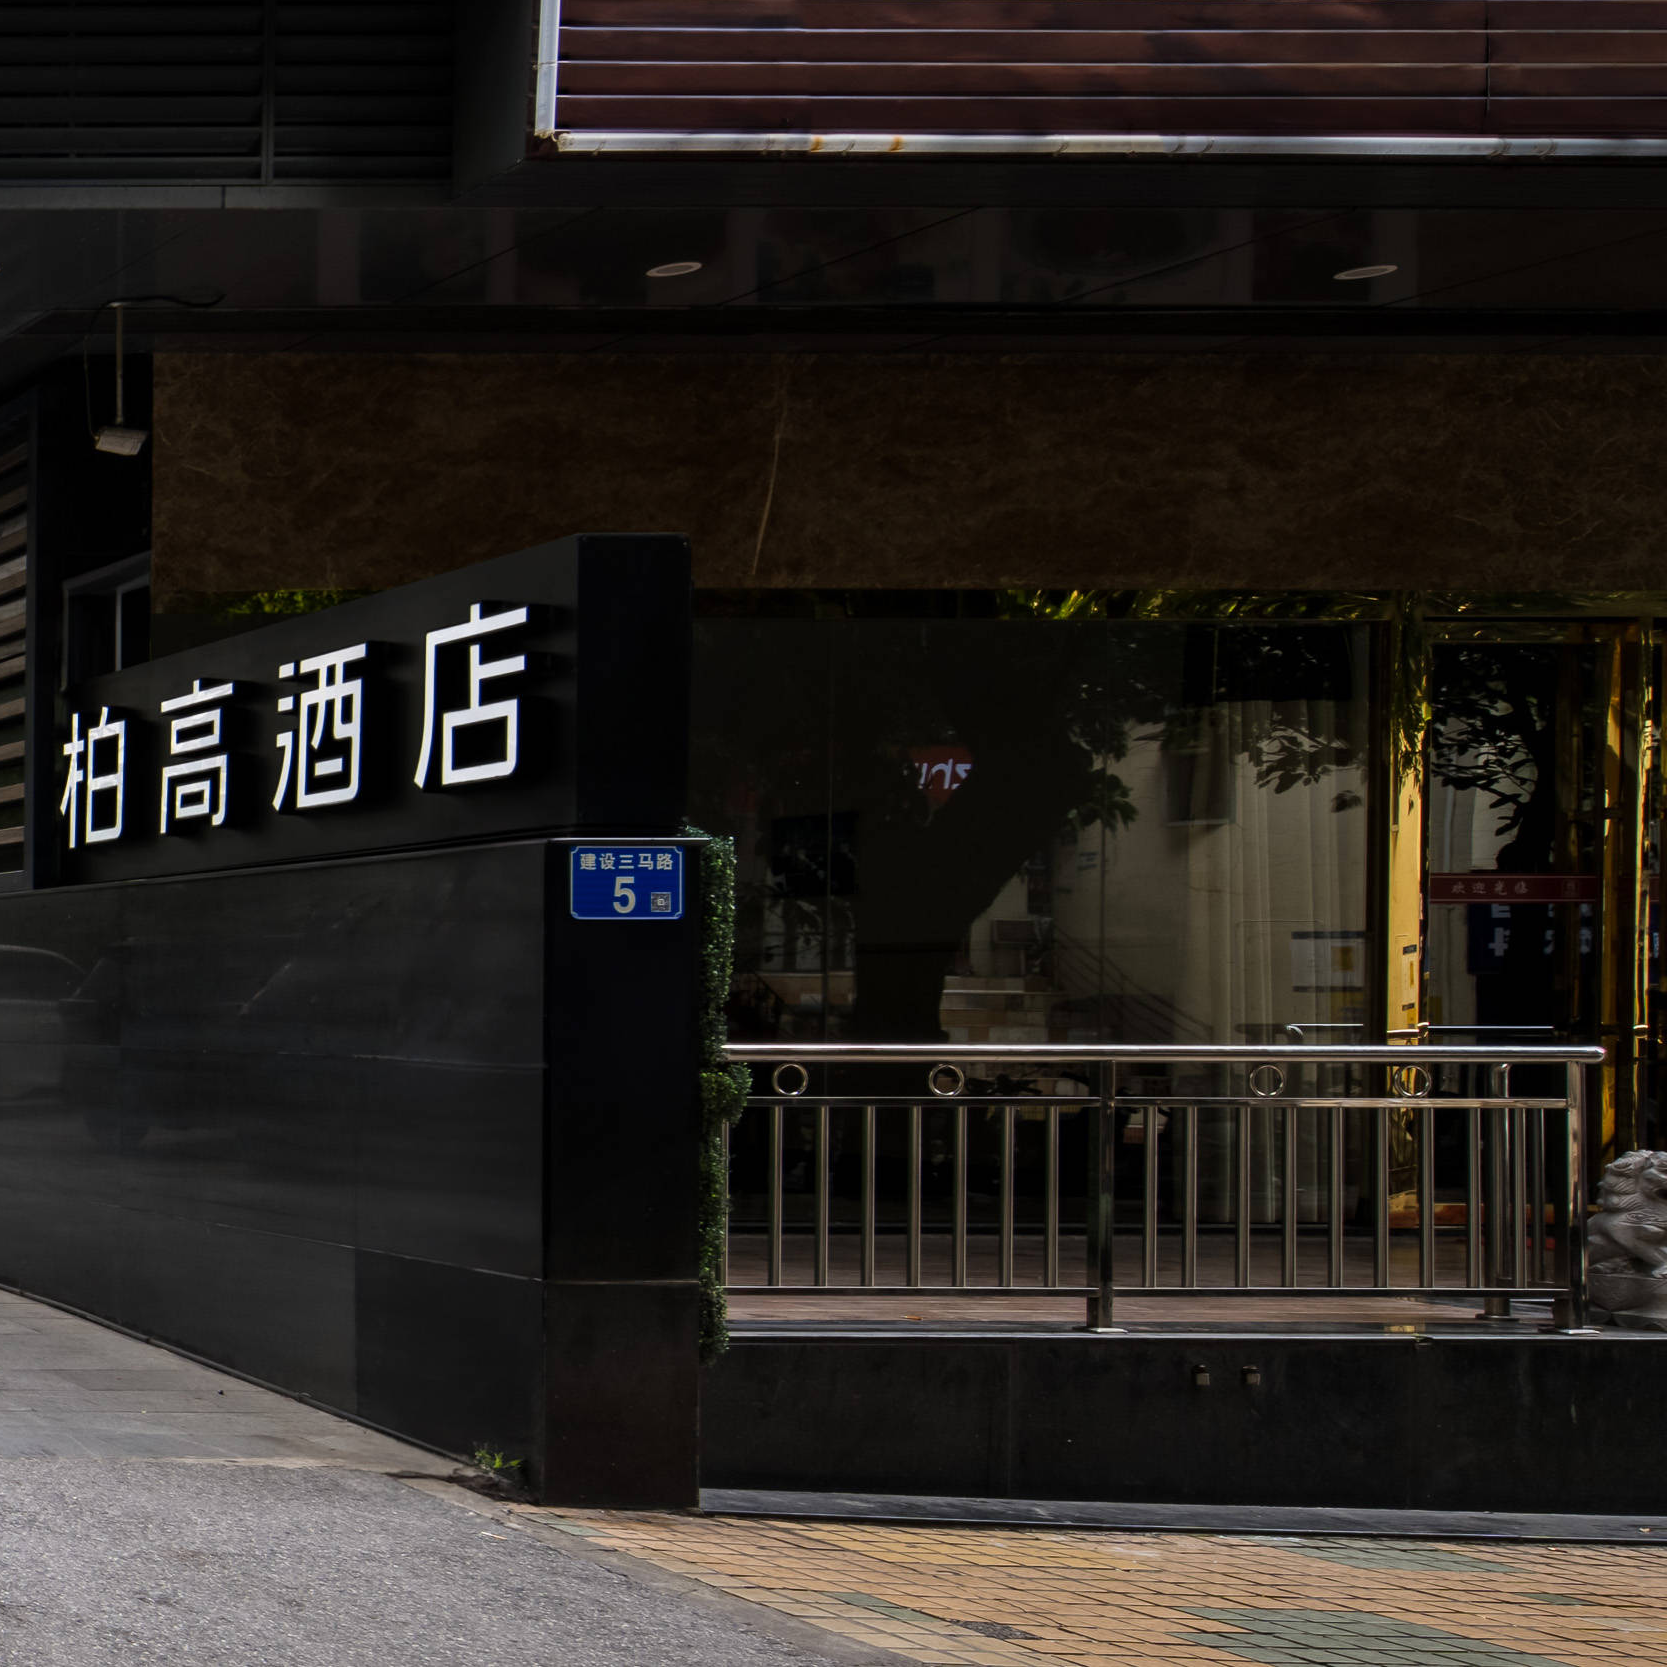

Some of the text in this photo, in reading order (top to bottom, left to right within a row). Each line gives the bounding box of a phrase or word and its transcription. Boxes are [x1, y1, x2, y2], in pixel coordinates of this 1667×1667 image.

[61, 604, 526, 847] 柏高酒店
[579, 853, 673, 870] 建设三马路
[613, 876, 636, 914] 5
